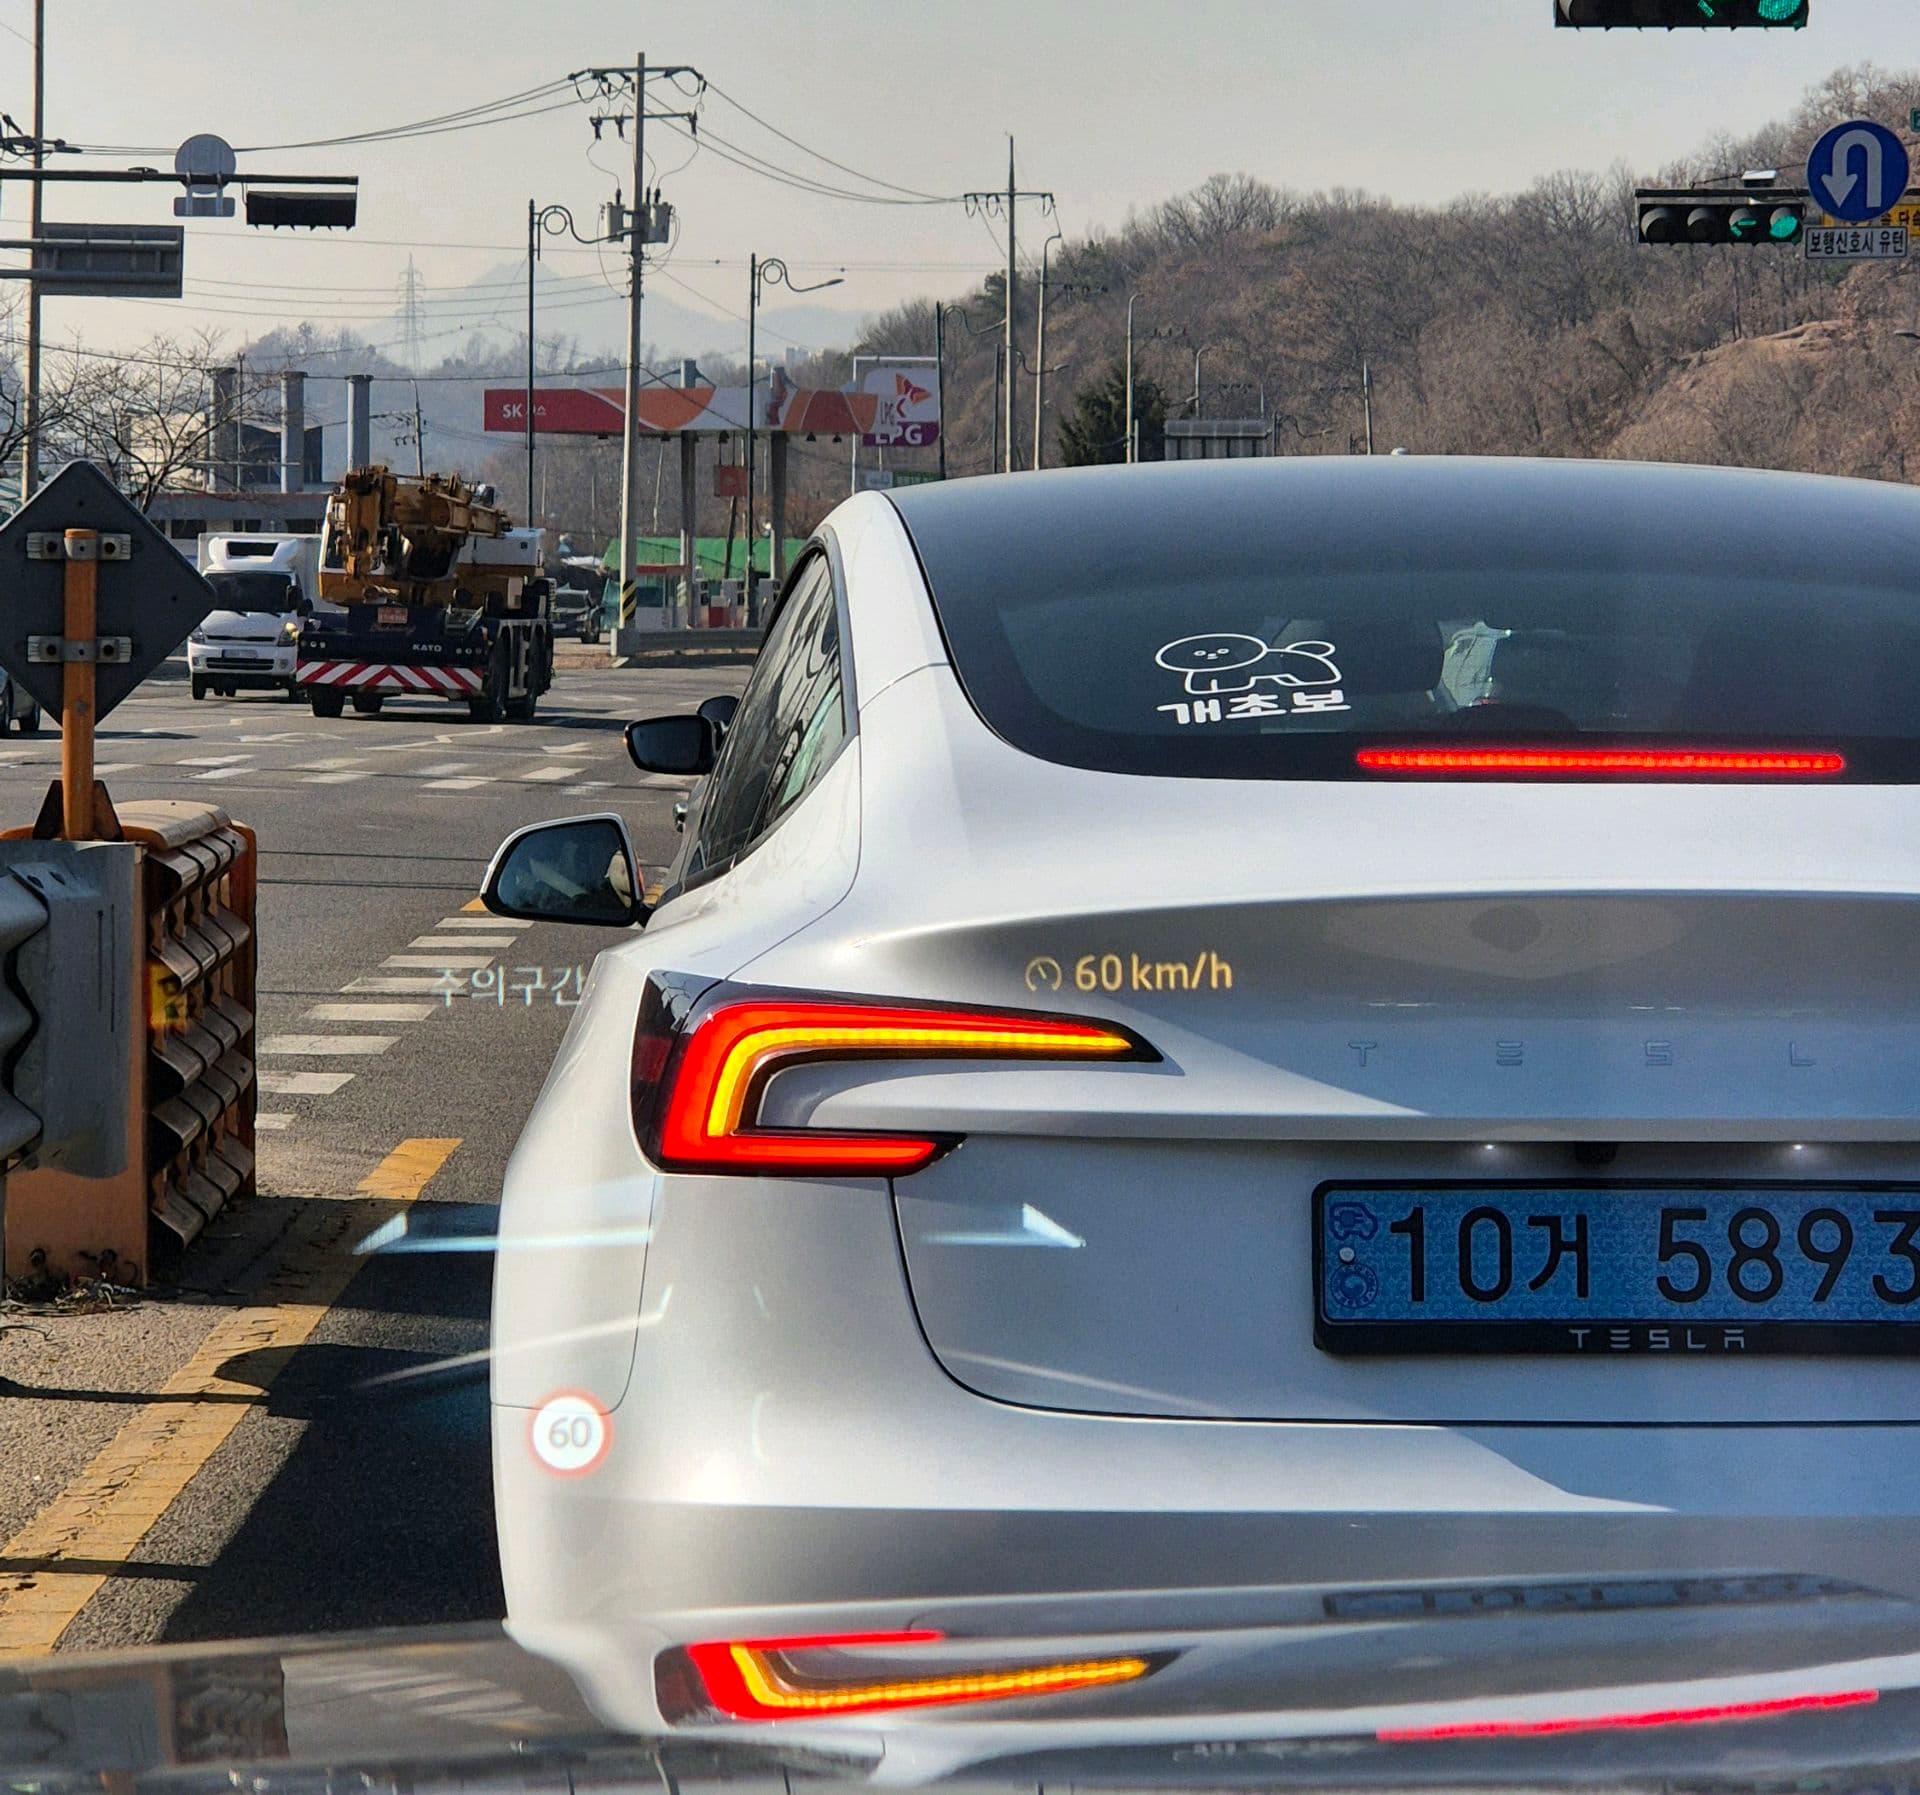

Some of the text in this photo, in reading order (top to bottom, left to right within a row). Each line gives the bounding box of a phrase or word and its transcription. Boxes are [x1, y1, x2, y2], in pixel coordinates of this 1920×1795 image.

[1810, 231, 1904, 254] 보행신호시 유턴
[412, 643, 442, 652] KATO
[1156, 689, 1351, 725] 개초보
[432, 964, 584, 1007] 주의구간
[1075, 951, 1233, 992] 60 km/h
[1390, 1205, 1589, 1302] 10거
[1655, 1207, 1920, 1305] 5893
[1568, 1328, 1745, 1350] TESLA
[548, 1415, 592, 1450] 60
